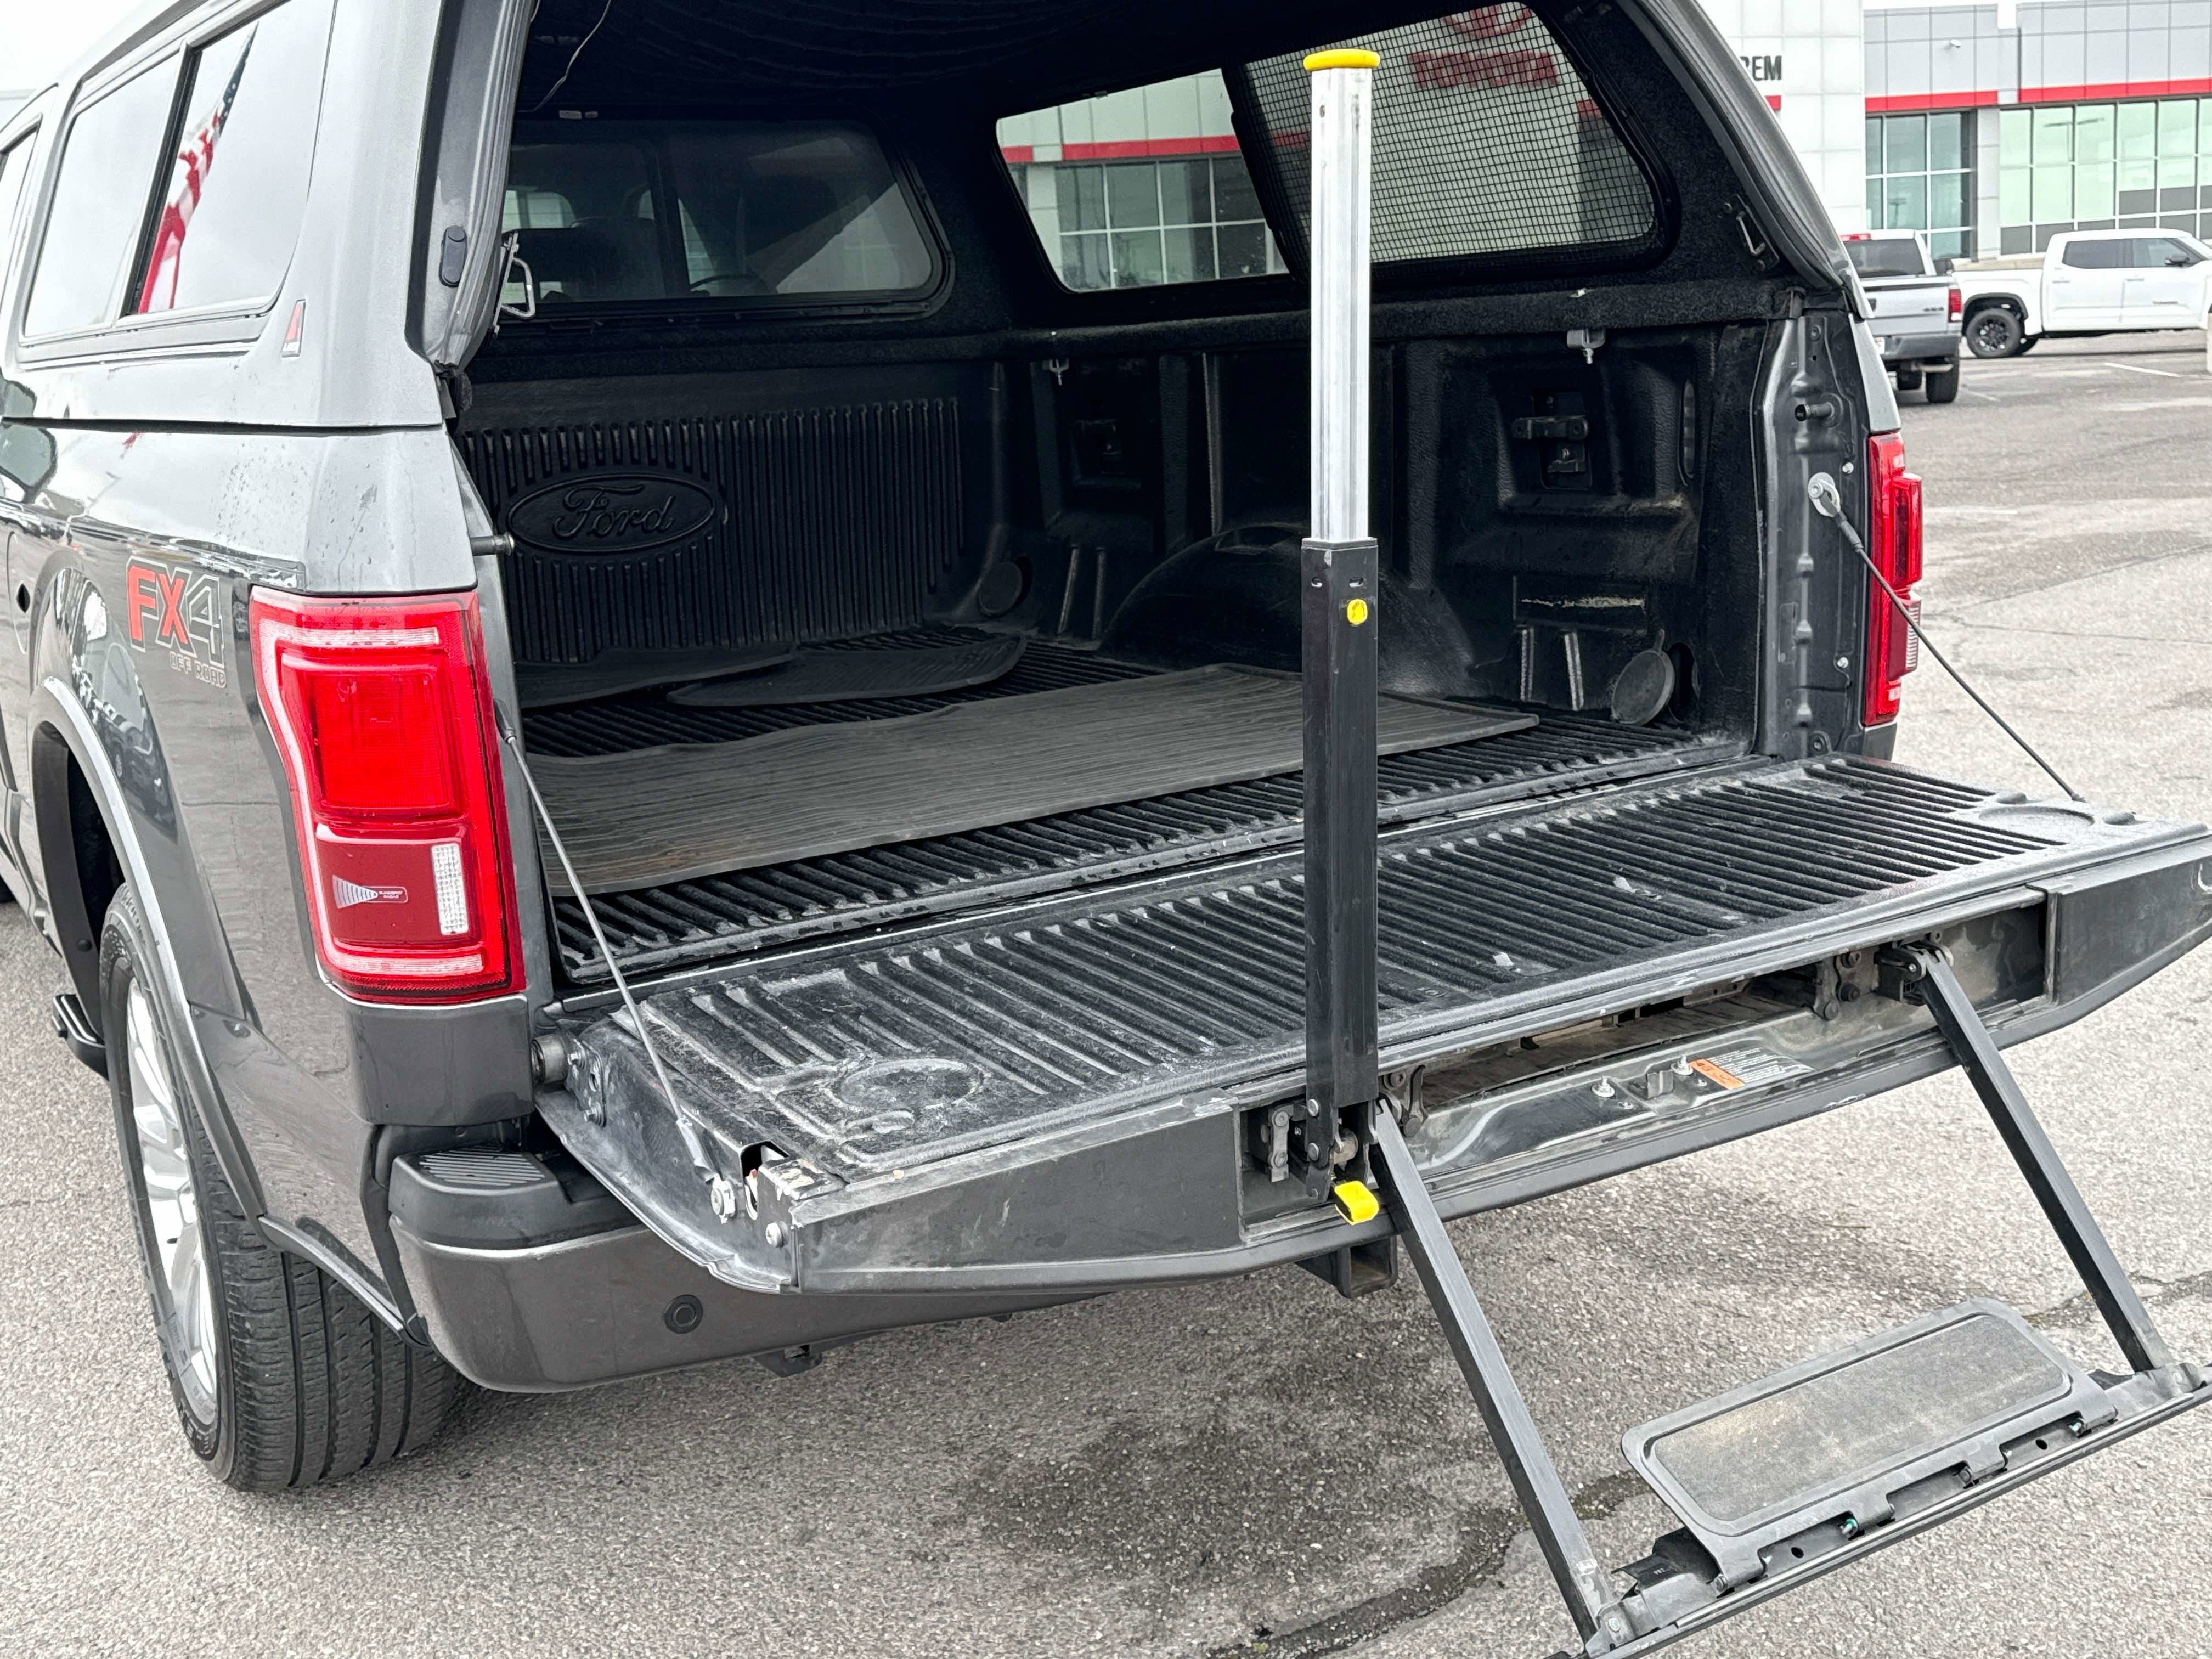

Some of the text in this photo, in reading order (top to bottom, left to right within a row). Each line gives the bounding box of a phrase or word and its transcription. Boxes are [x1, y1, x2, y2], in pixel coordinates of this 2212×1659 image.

[553, 483, 675, 540] Ford
[126, 555, 225, 668] FX4
[169, 651, 227, 689] OFF ROAD
